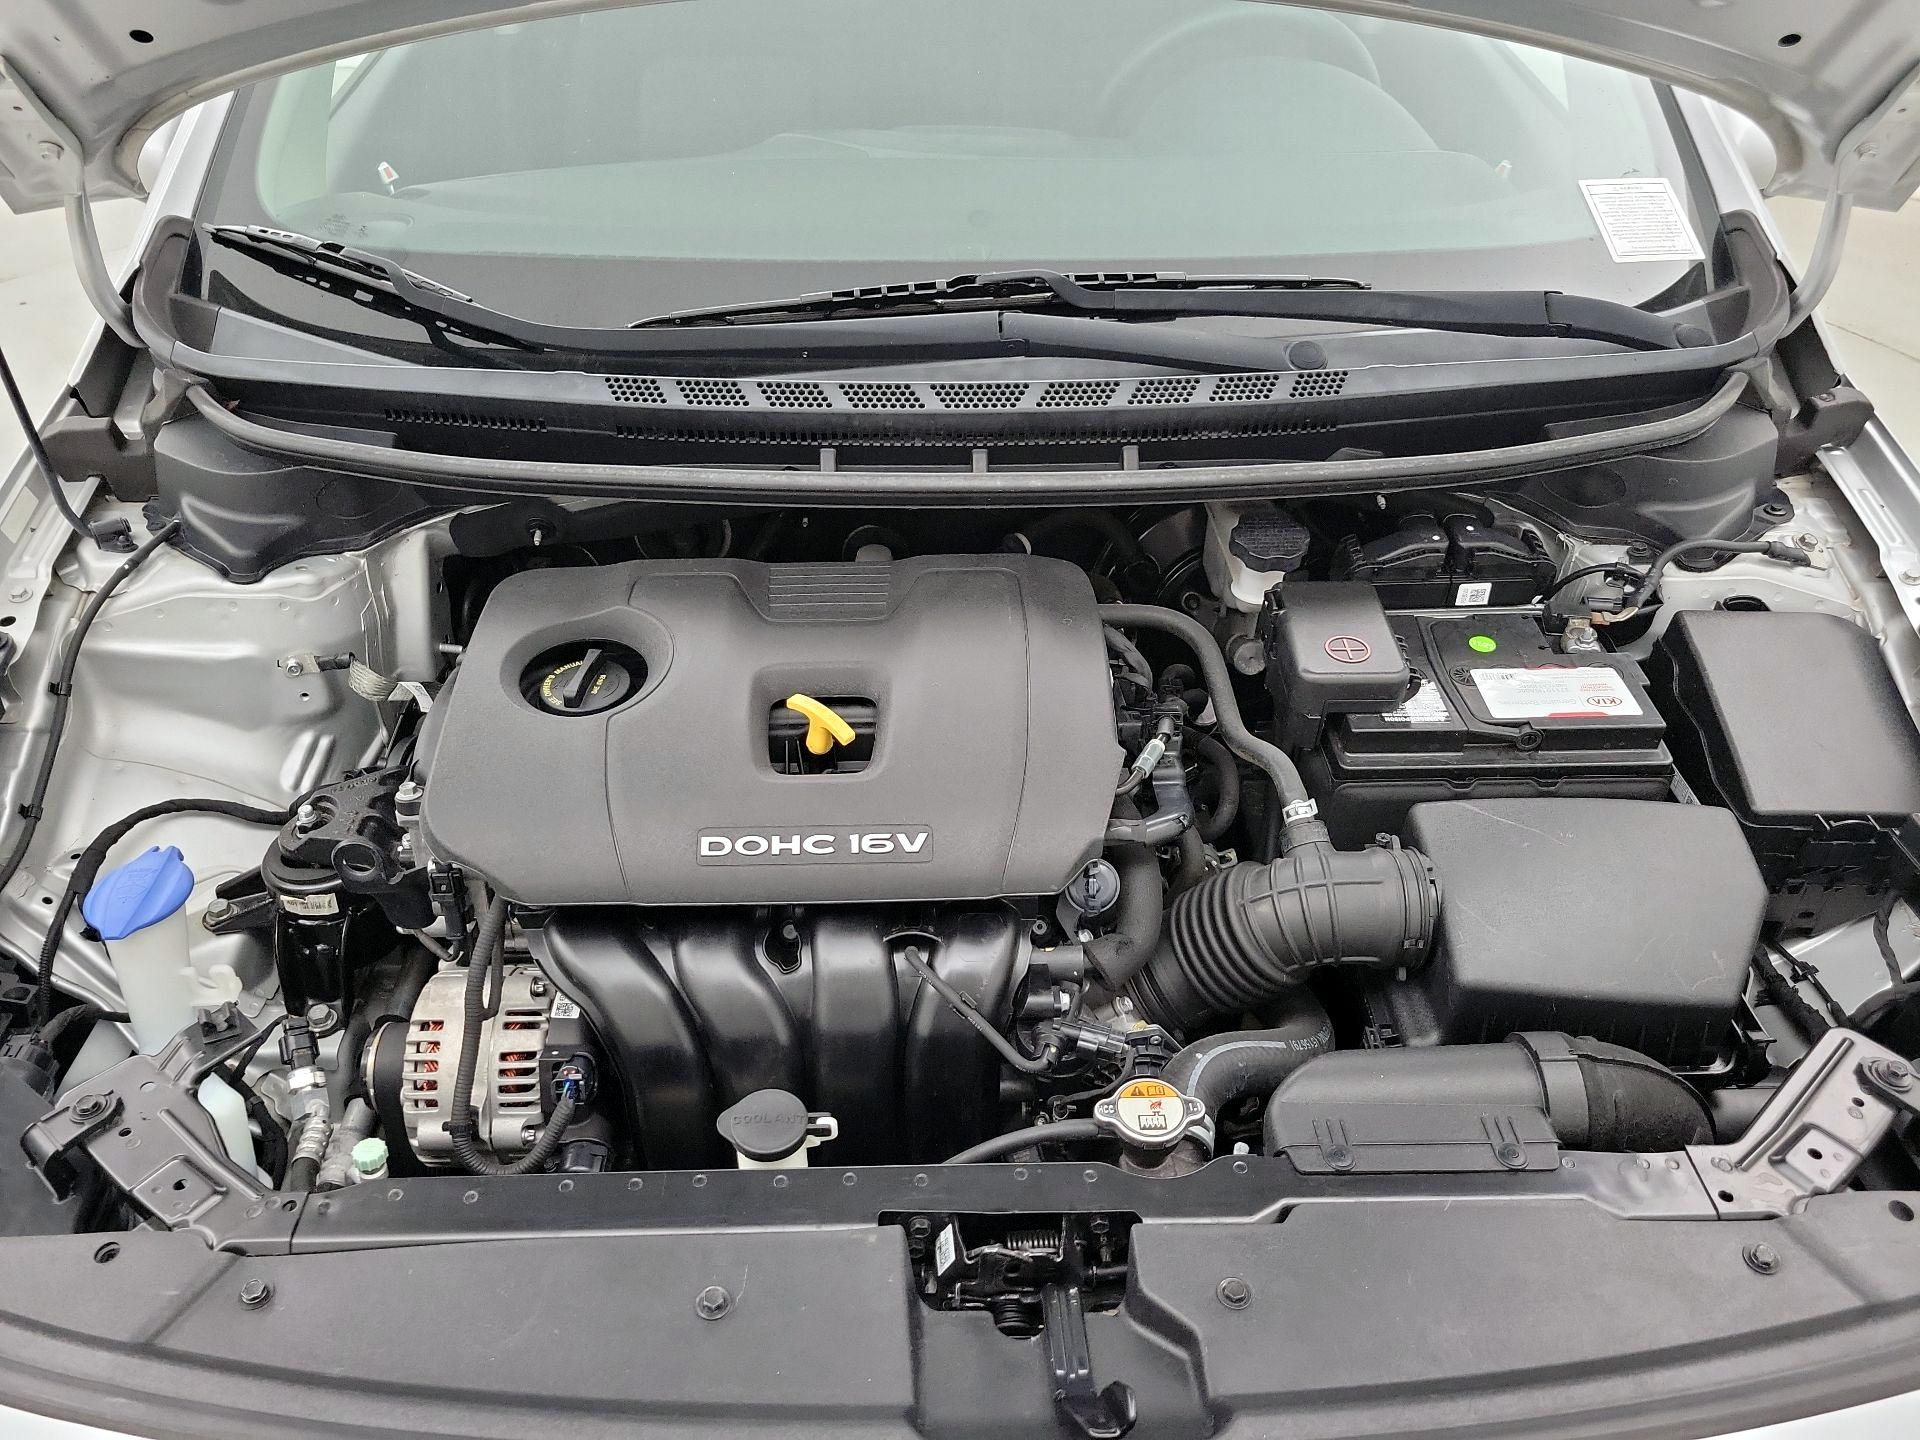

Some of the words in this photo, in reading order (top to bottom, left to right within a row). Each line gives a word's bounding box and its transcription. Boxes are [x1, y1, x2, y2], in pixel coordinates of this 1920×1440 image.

[1591, 697, 1618, 707] KIA
[700, 834, 836, 857] DOHC
[849, 832, 929, 854] 16V
[733, 1113, 806, 1125] COOLANT
